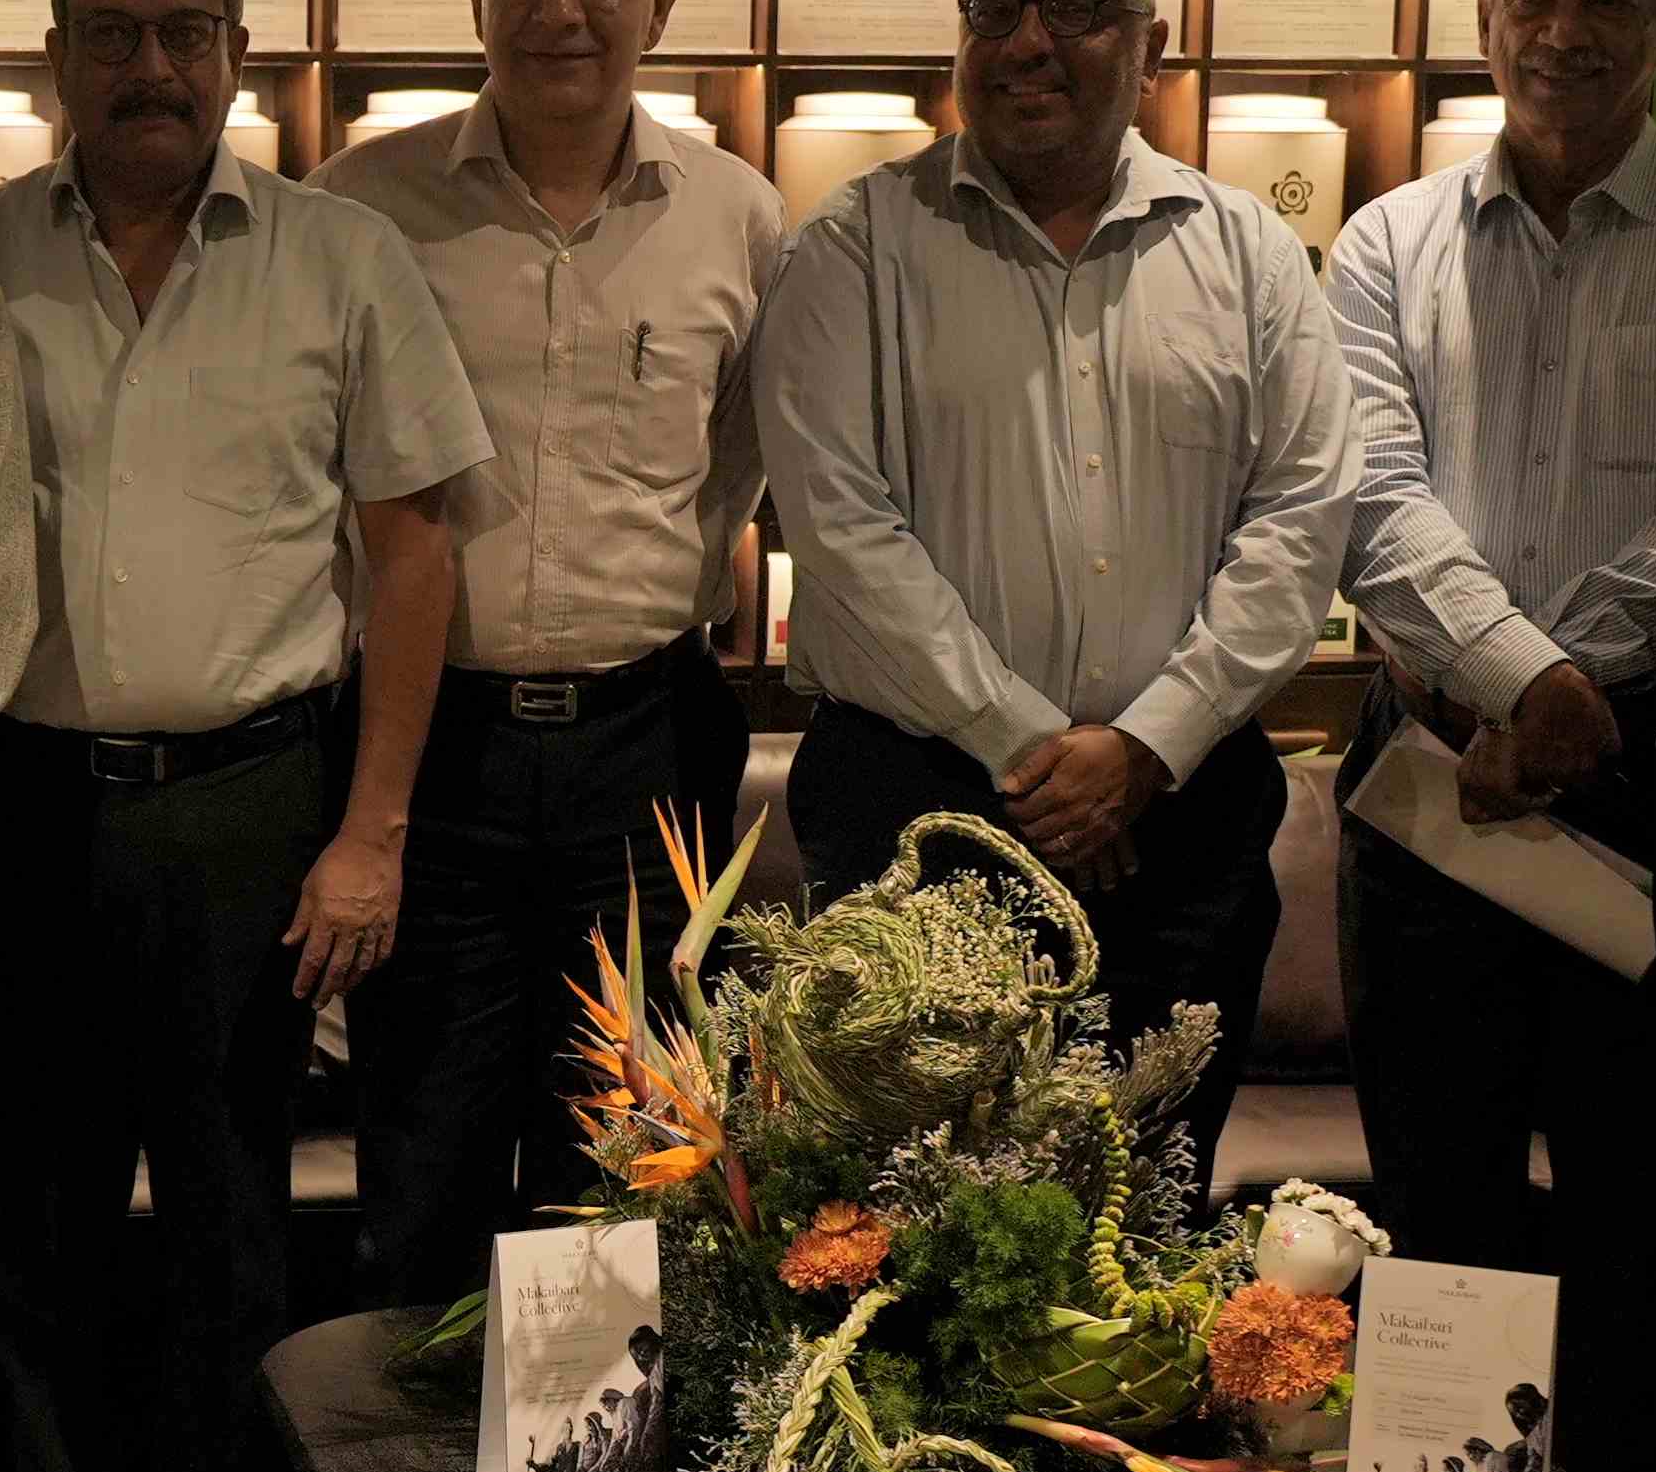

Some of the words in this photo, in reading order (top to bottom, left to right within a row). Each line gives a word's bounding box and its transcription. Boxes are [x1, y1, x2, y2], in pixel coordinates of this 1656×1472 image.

[517, 1283, 580, 1301] Makaibari
[518, 1301, 580, 1318] Collective
[1378, 1312, 1454, 1334] Makaibari
[1376, 1330, 1452, 1352] Collective
